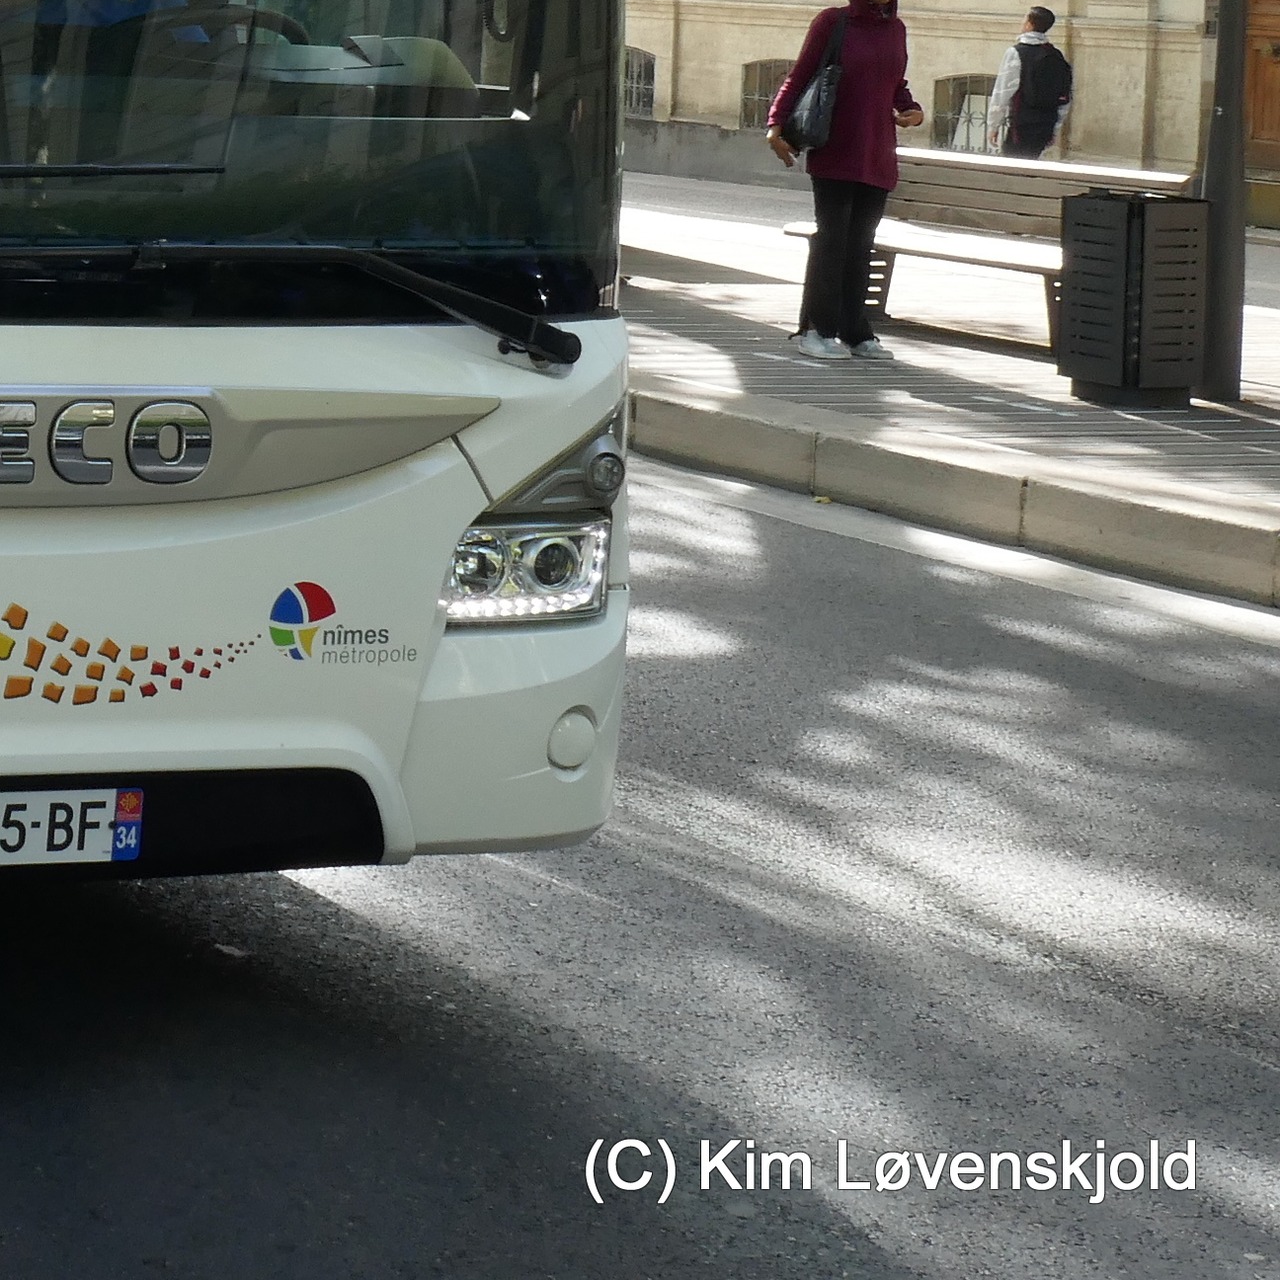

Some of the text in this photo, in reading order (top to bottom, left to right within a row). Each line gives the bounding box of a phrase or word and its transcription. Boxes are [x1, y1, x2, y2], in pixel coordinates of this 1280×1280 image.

[322, 624, 389, 646] nîmes
[321, 644, 418, 666] métropole
[115, 825, 137, 849] 34
